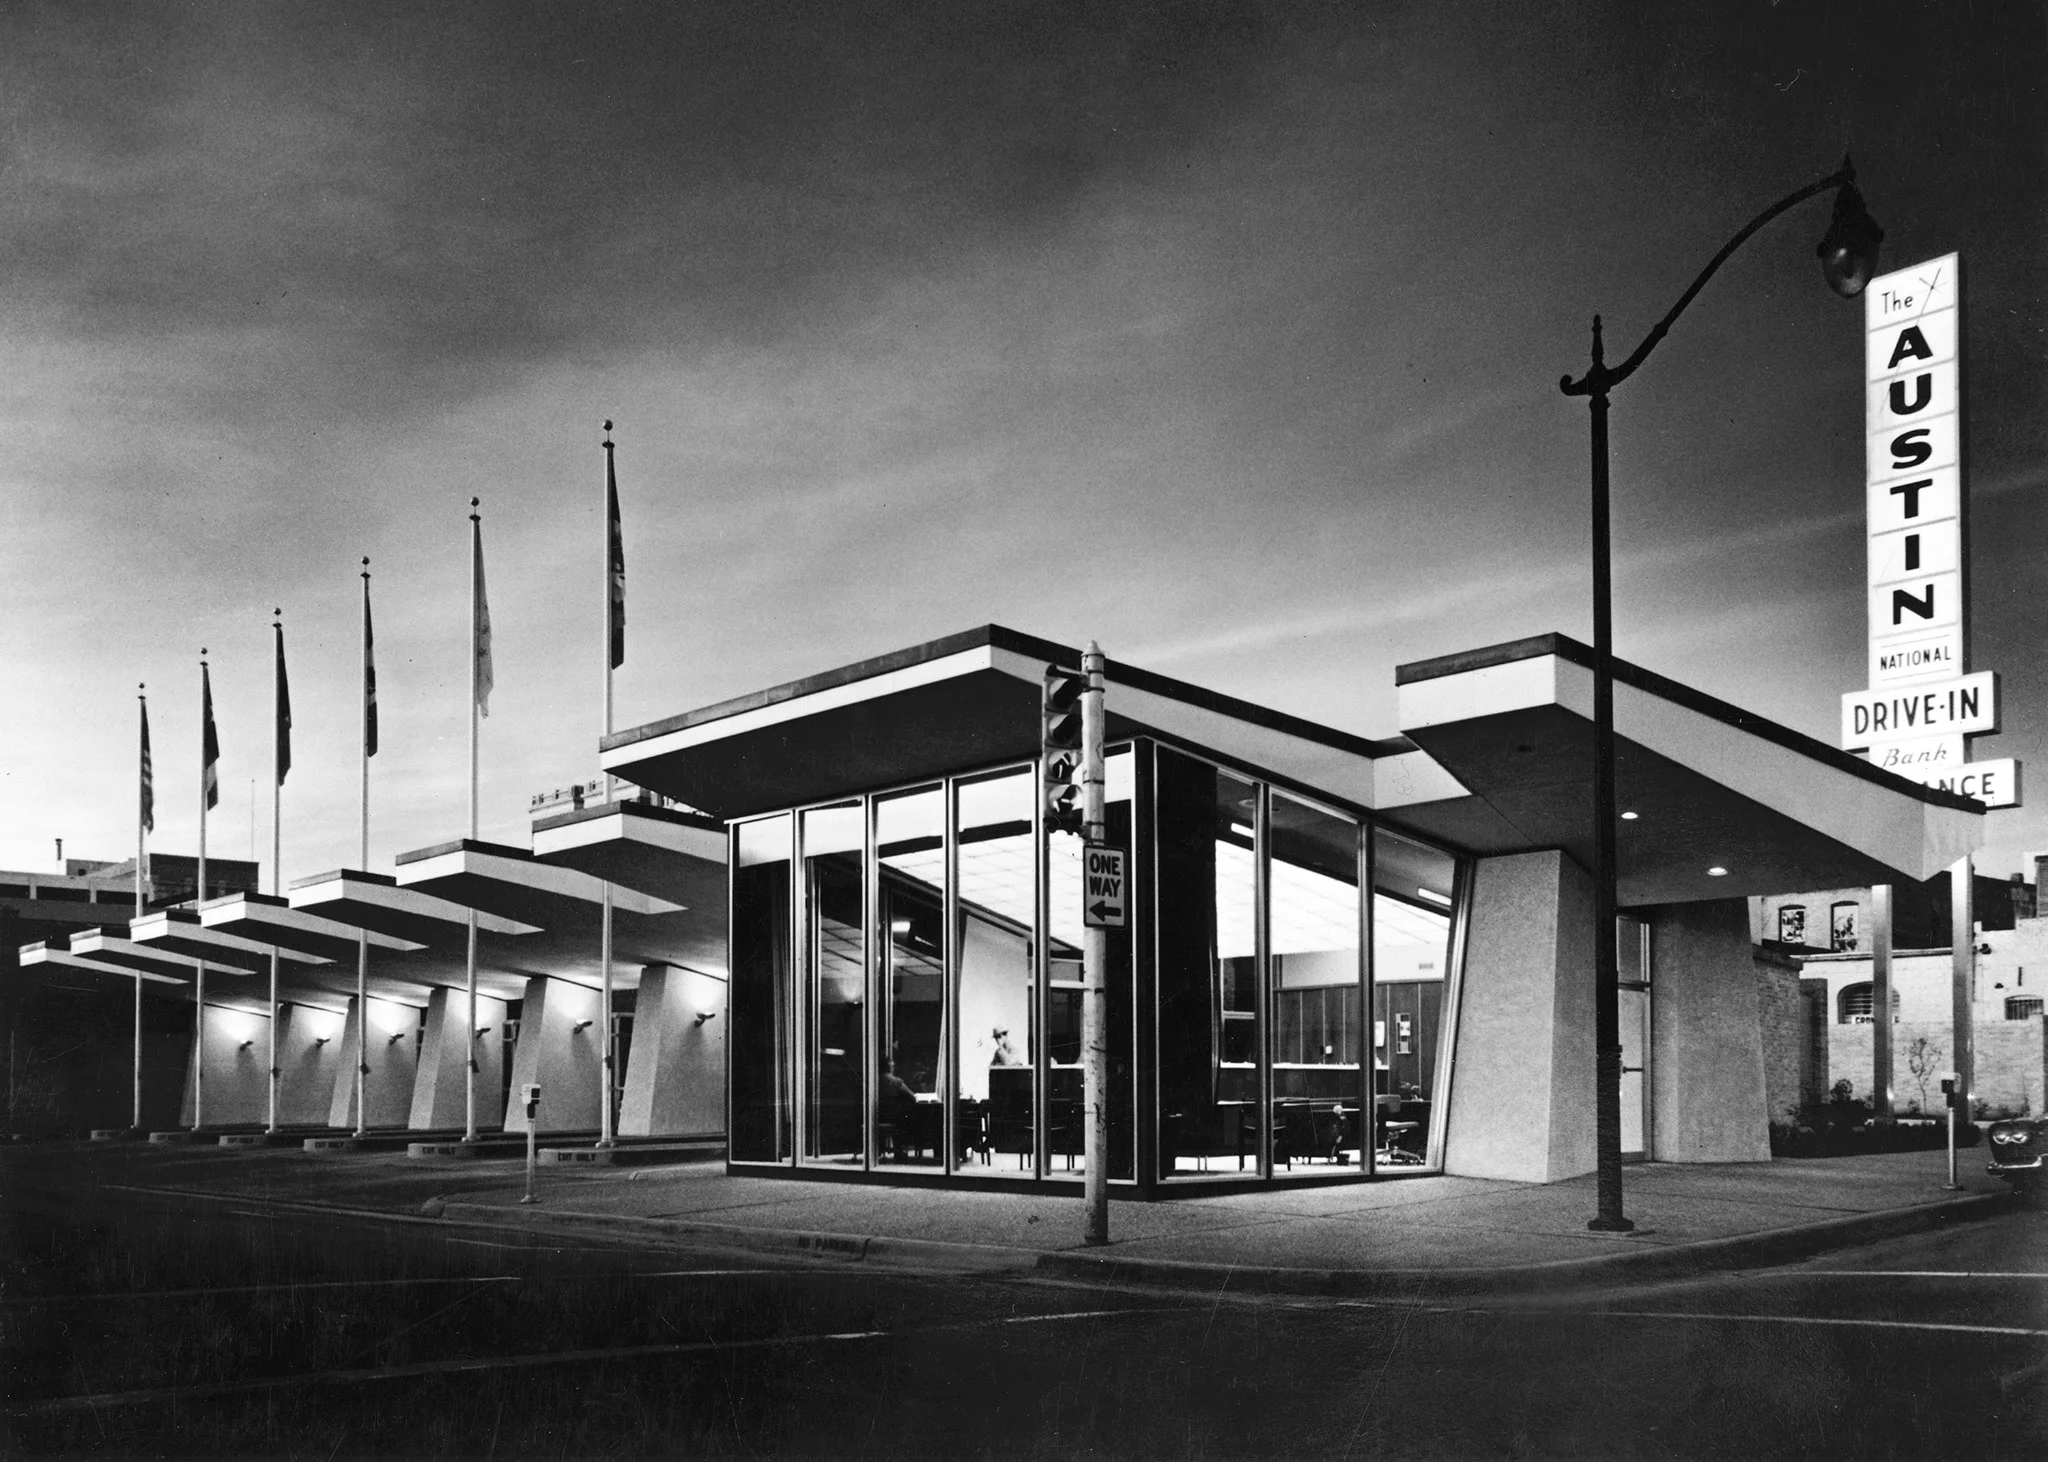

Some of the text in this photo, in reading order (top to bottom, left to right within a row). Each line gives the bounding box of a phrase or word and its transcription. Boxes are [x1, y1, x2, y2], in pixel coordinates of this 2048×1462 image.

[1881, 290, 1914, 314] The
[1888, 325, 1934, 625] AUSTIN
[1880, 645, 1951, 670] NATIONAL
[1854, 686, 1979, 735] DRIVE-IN
[1882, 742, 1947, 767] Bank
[1089, 853, 1121, 876] ONE
[1089, 876, 1122, 898] WAY
